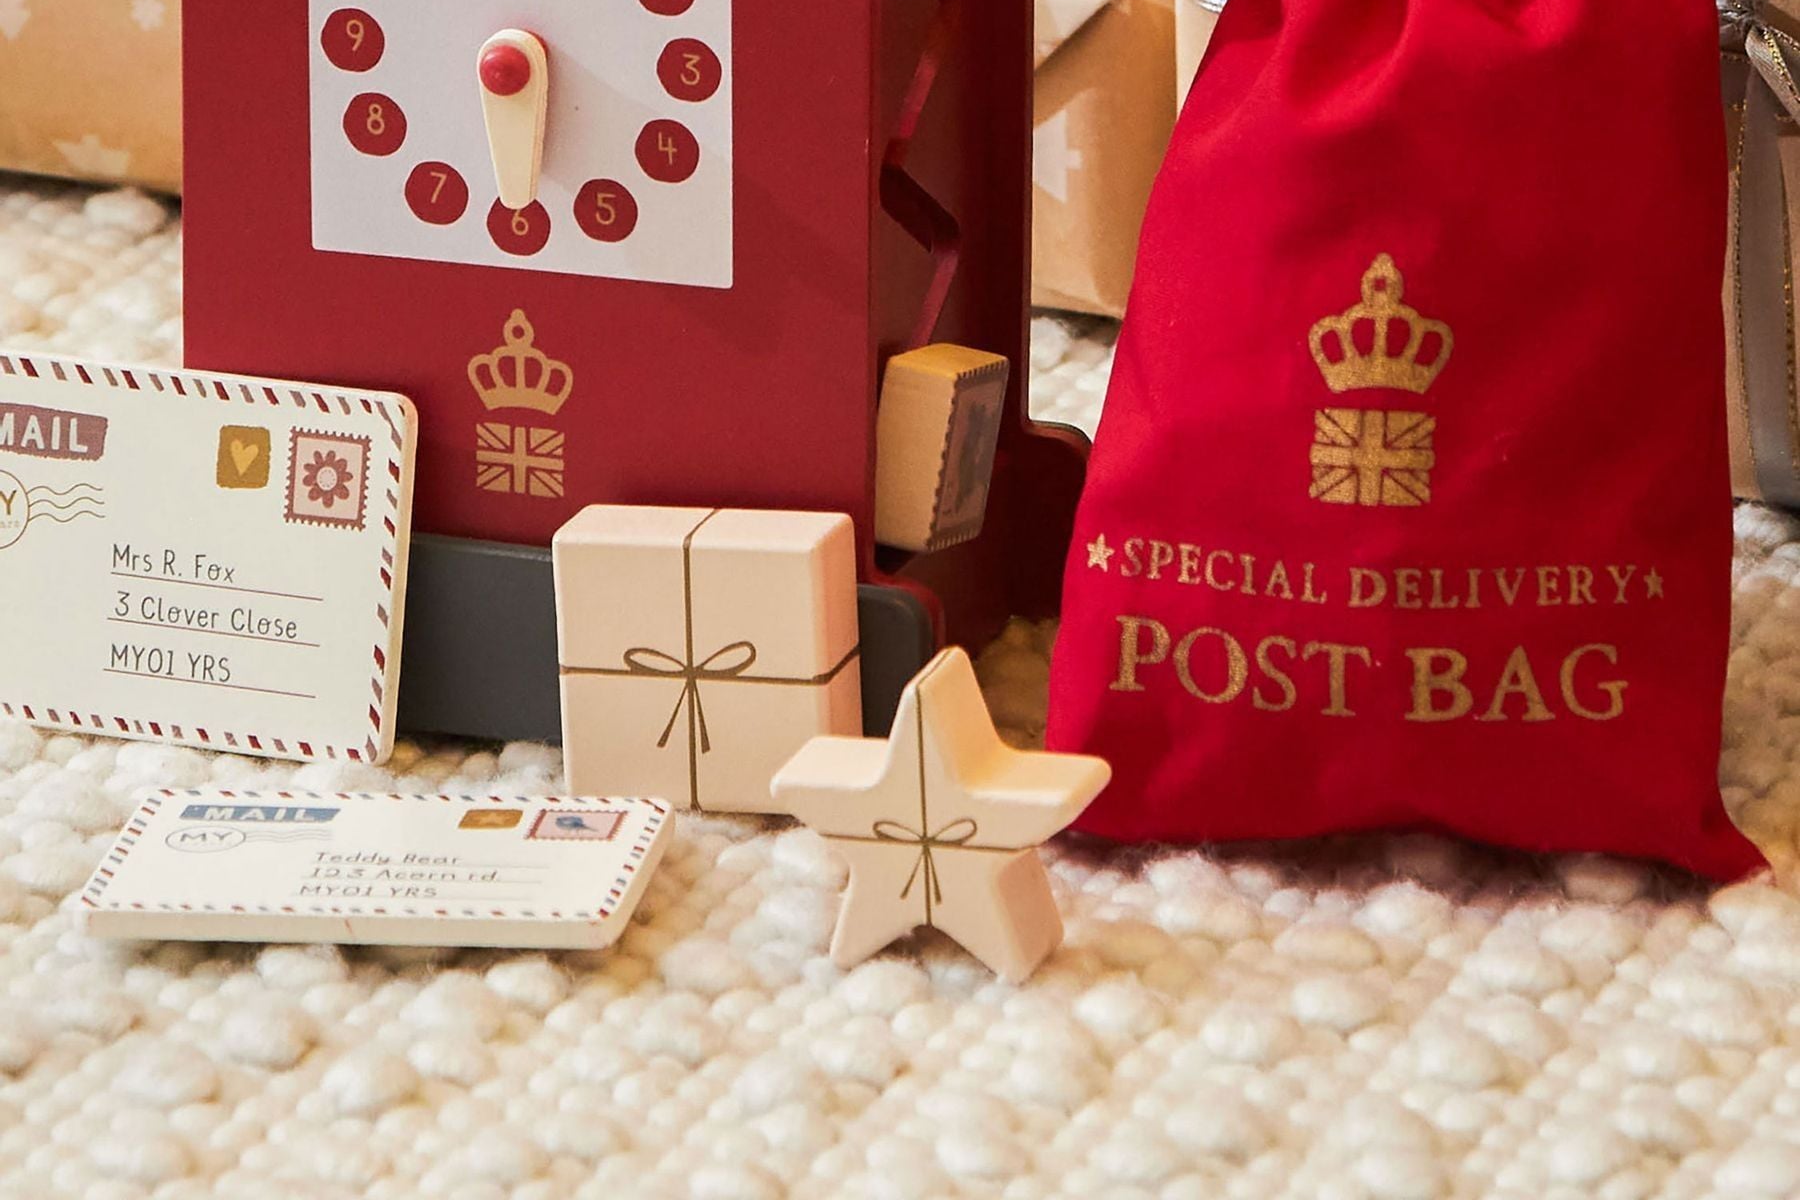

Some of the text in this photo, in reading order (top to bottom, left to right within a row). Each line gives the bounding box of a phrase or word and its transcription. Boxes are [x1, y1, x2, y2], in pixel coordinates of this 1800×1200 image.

[345, 19, 365, 52] 9
[679, 54, 701, 86] 3
[365, 103, 385, 135] 8
[657, 131, 678, 165] 4
[429, 171, 448, 203] 7
[510, 207, 529, 236] 6
[595, 193, 616, 226] 5
[0, 412, 88, 453] MAIL
[112, 543, 236, 583] Mrs R. Fox
[1121, 538, 1637, 610] SPECIAL DELIVERY
[115, 590, 297, 639] 3 Clover Close
[187, 652, 231, 683] YRS
[1108, 614, 1629, 723] POST BAG
[204, 807, 316, 821] MAIL
[180, 831, 233, 843] MY
[311, 867, 366, 879] 123
[316, 851, 463, 866] Teddy Bear
[390, 886, 438, 898] YRS
